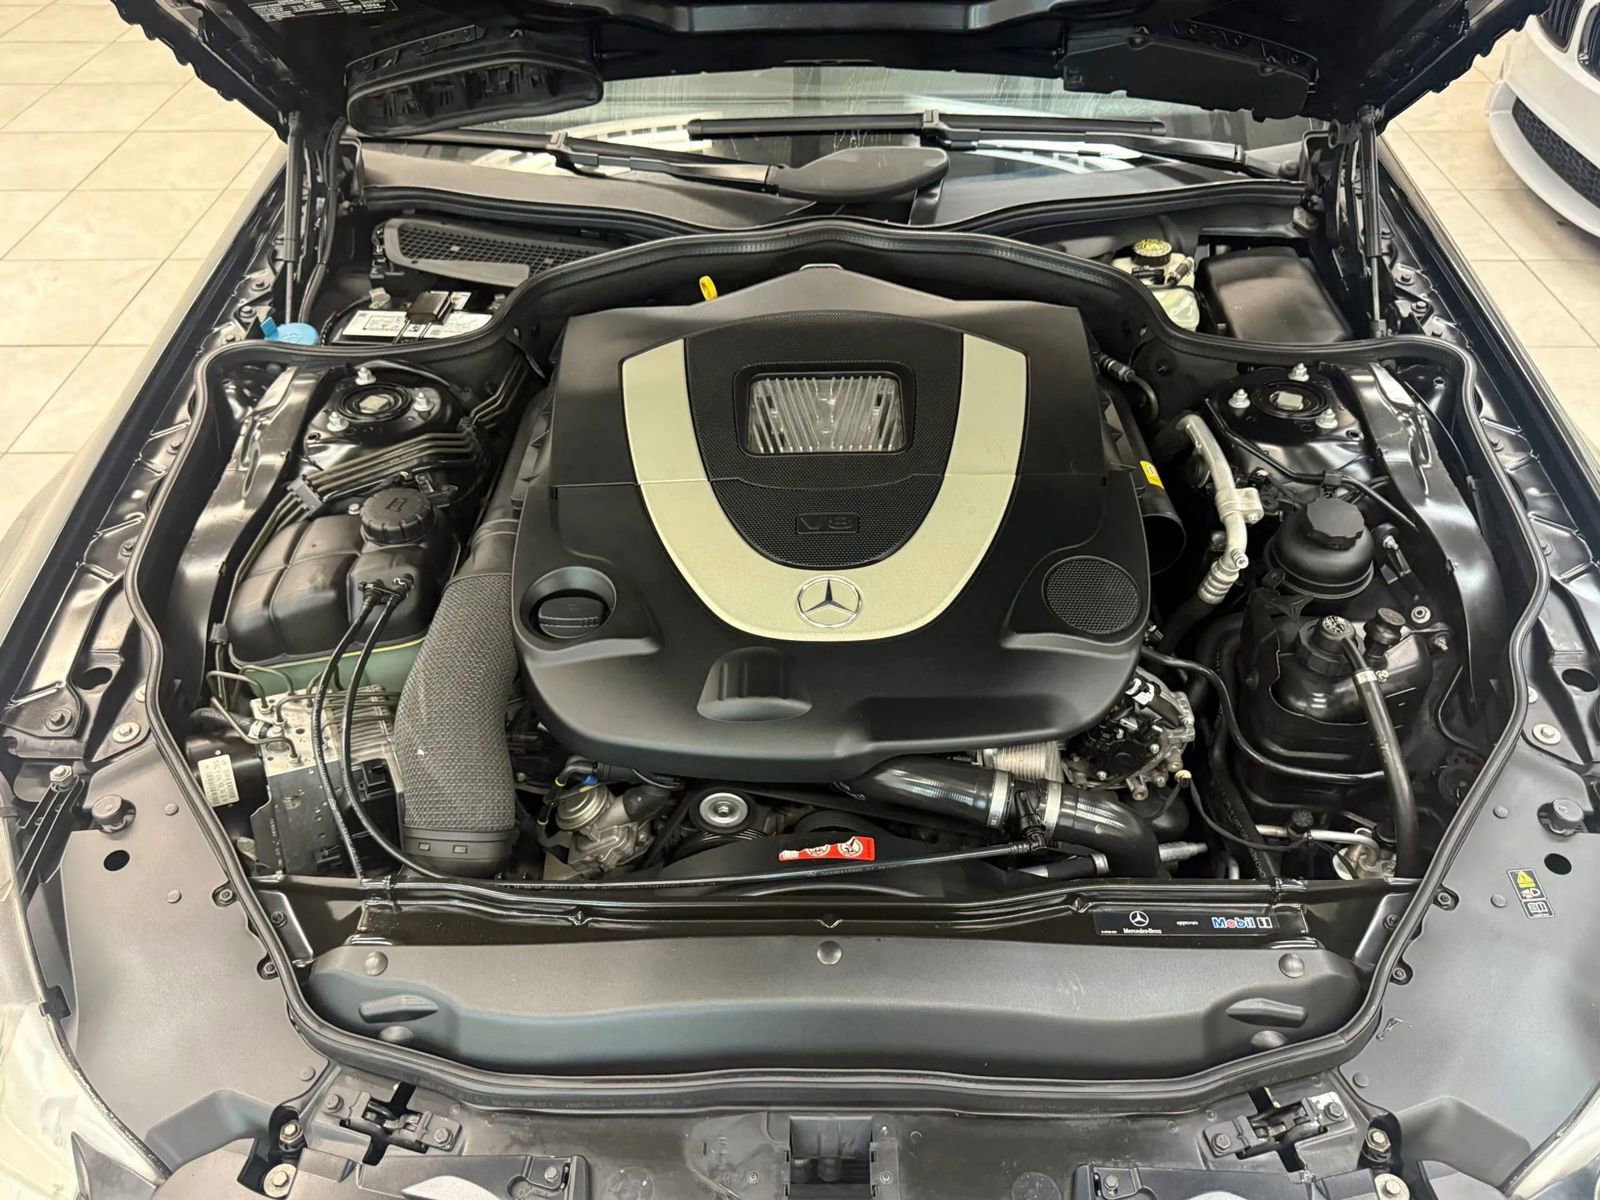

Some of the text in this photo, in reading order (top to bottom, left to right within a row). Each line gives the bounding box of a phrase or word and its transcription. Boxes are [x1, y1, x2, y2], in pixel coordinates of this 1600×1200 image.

[799, 515, 853, 530] V8
[1211, 916, 1273, 928] Mobil 1
